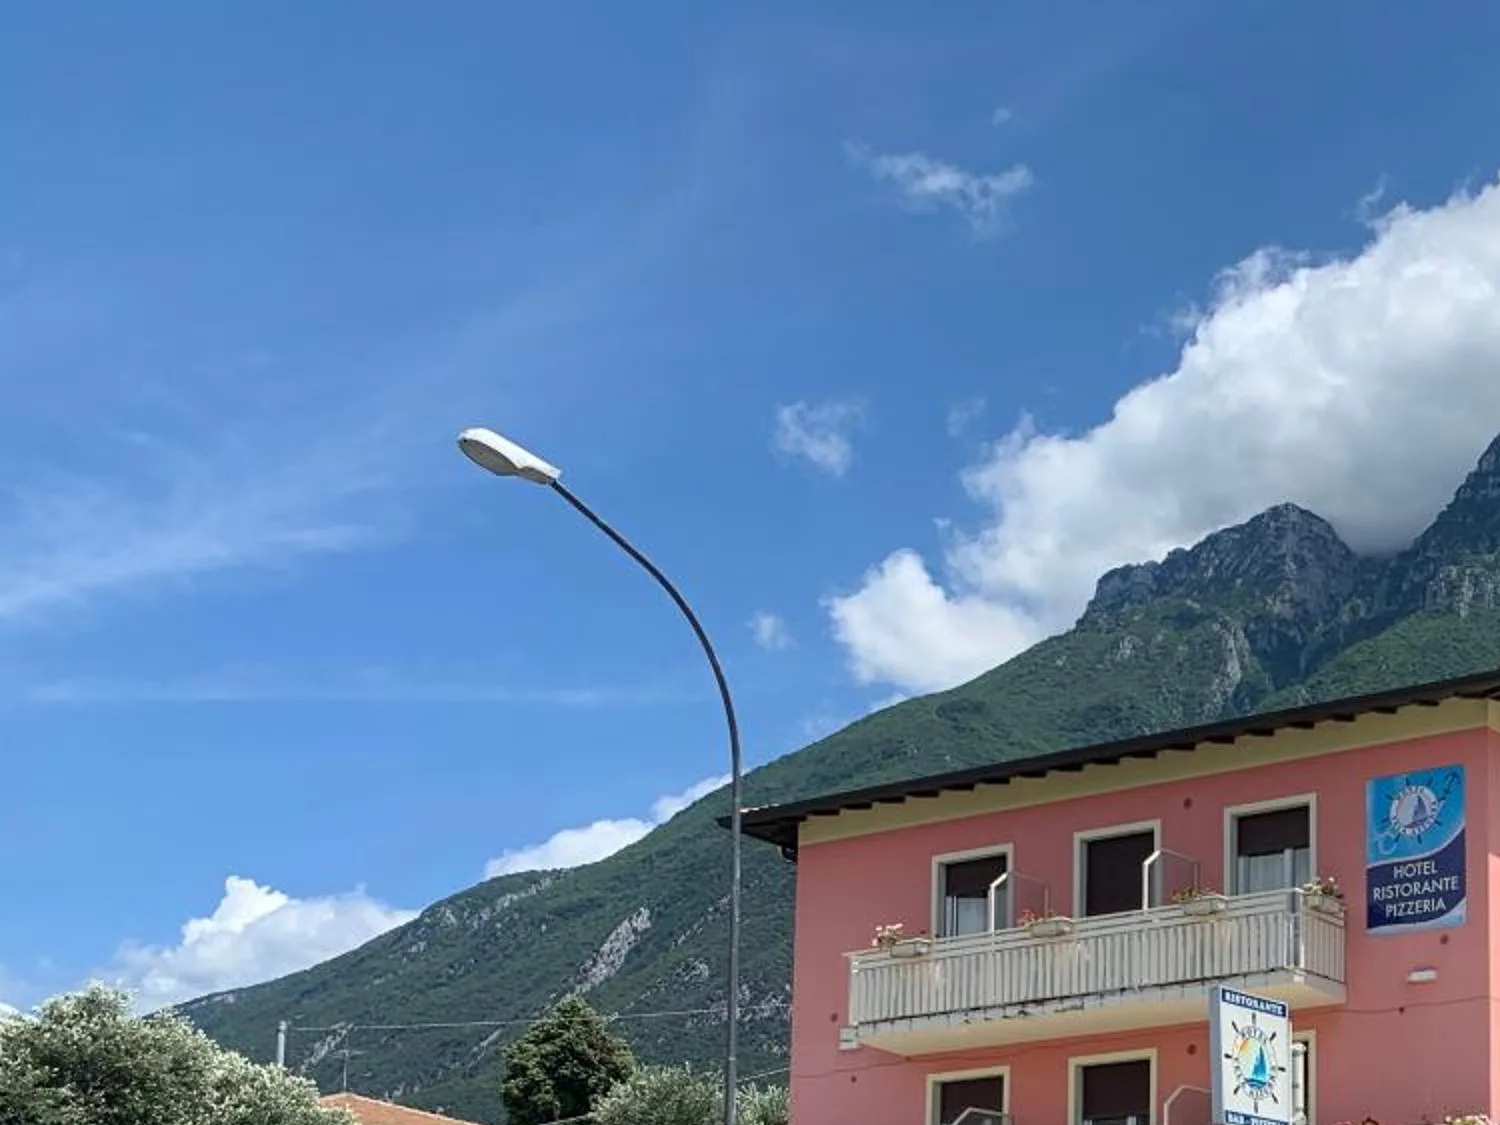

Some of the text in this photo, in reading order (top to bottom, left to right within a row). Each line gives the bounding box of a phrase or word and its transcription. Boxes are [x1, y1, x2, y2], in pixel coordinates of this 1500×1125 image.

[1393, 861, 1438, 880] HOTEL
[1373, 875, 1460, 901] RISTORANTE
[1385, 898, 1447, 919] PIZZERIA
